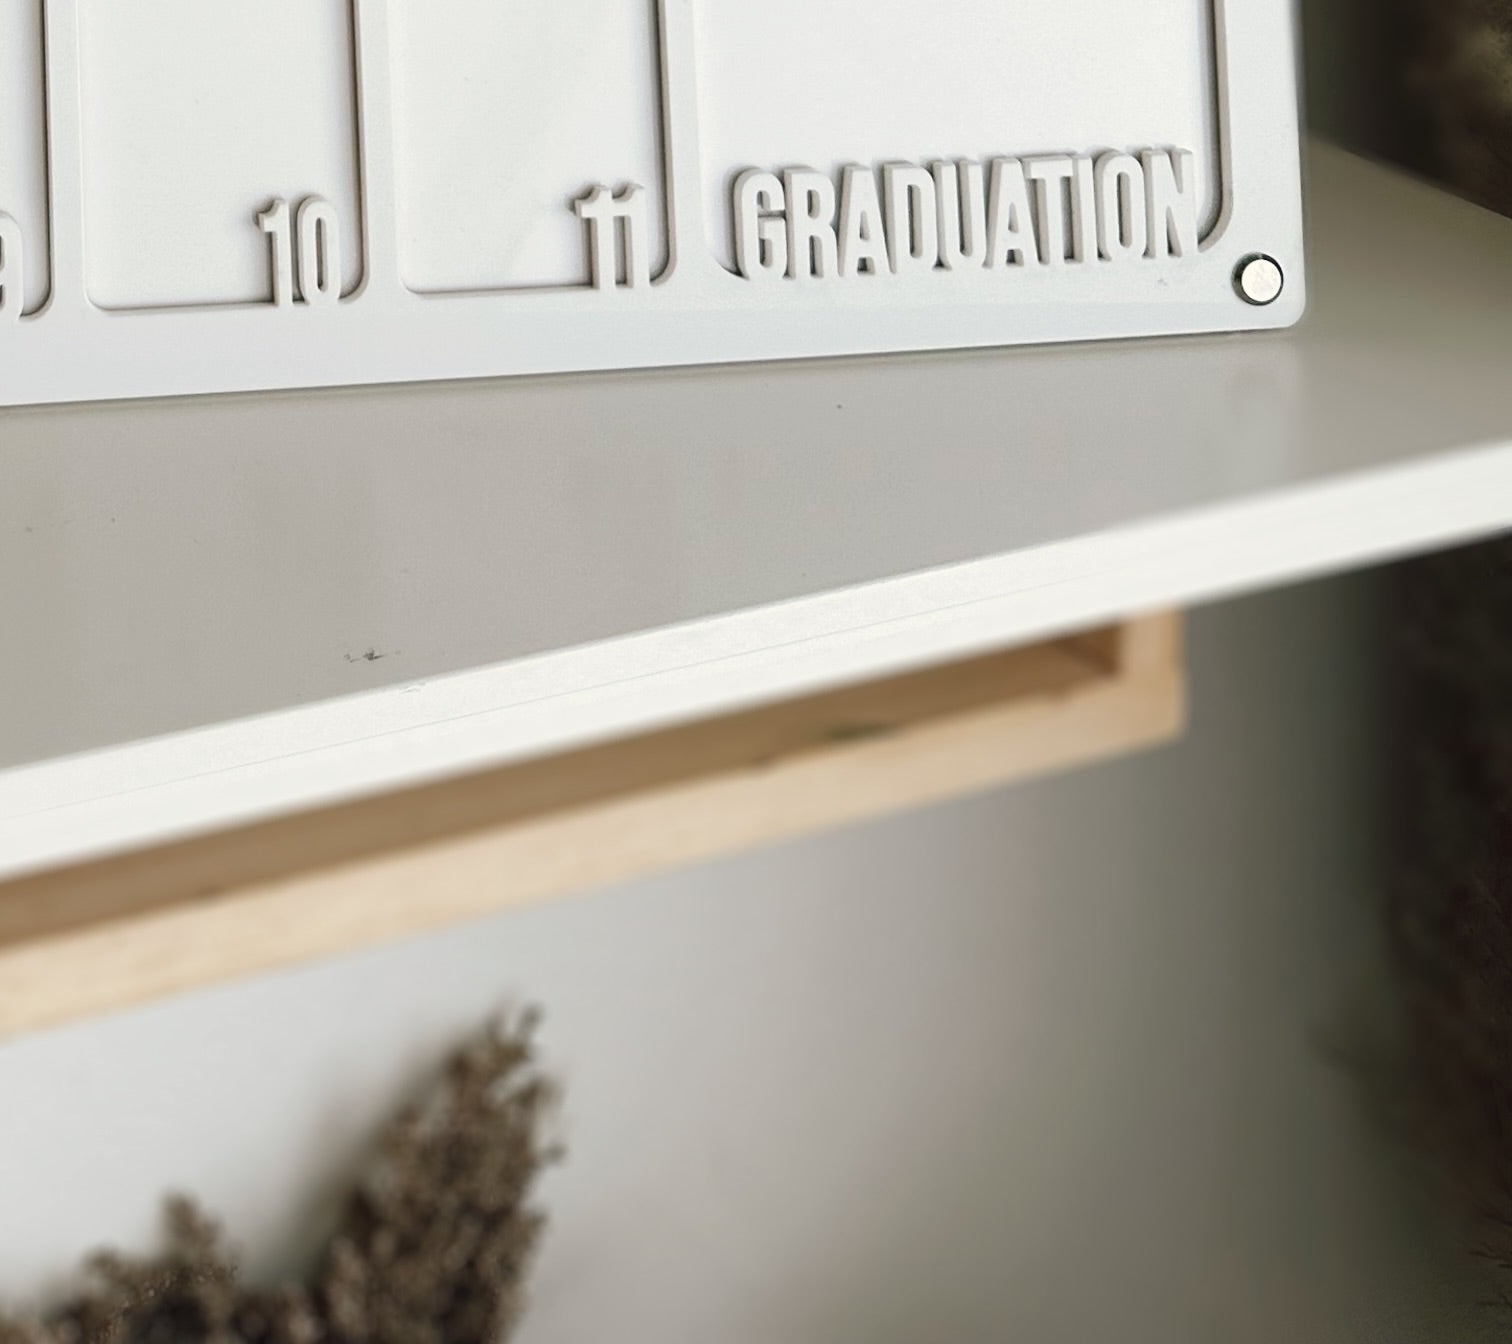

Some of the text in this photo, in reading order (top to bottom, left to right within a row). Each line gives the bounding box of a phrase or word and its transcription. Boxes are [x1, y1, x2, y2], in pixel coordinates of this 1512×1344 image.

[258, 193, 341, 308] 10
[575, 183, 650, 289] 11
[733, 145, 1199, 281] GRADUATION
